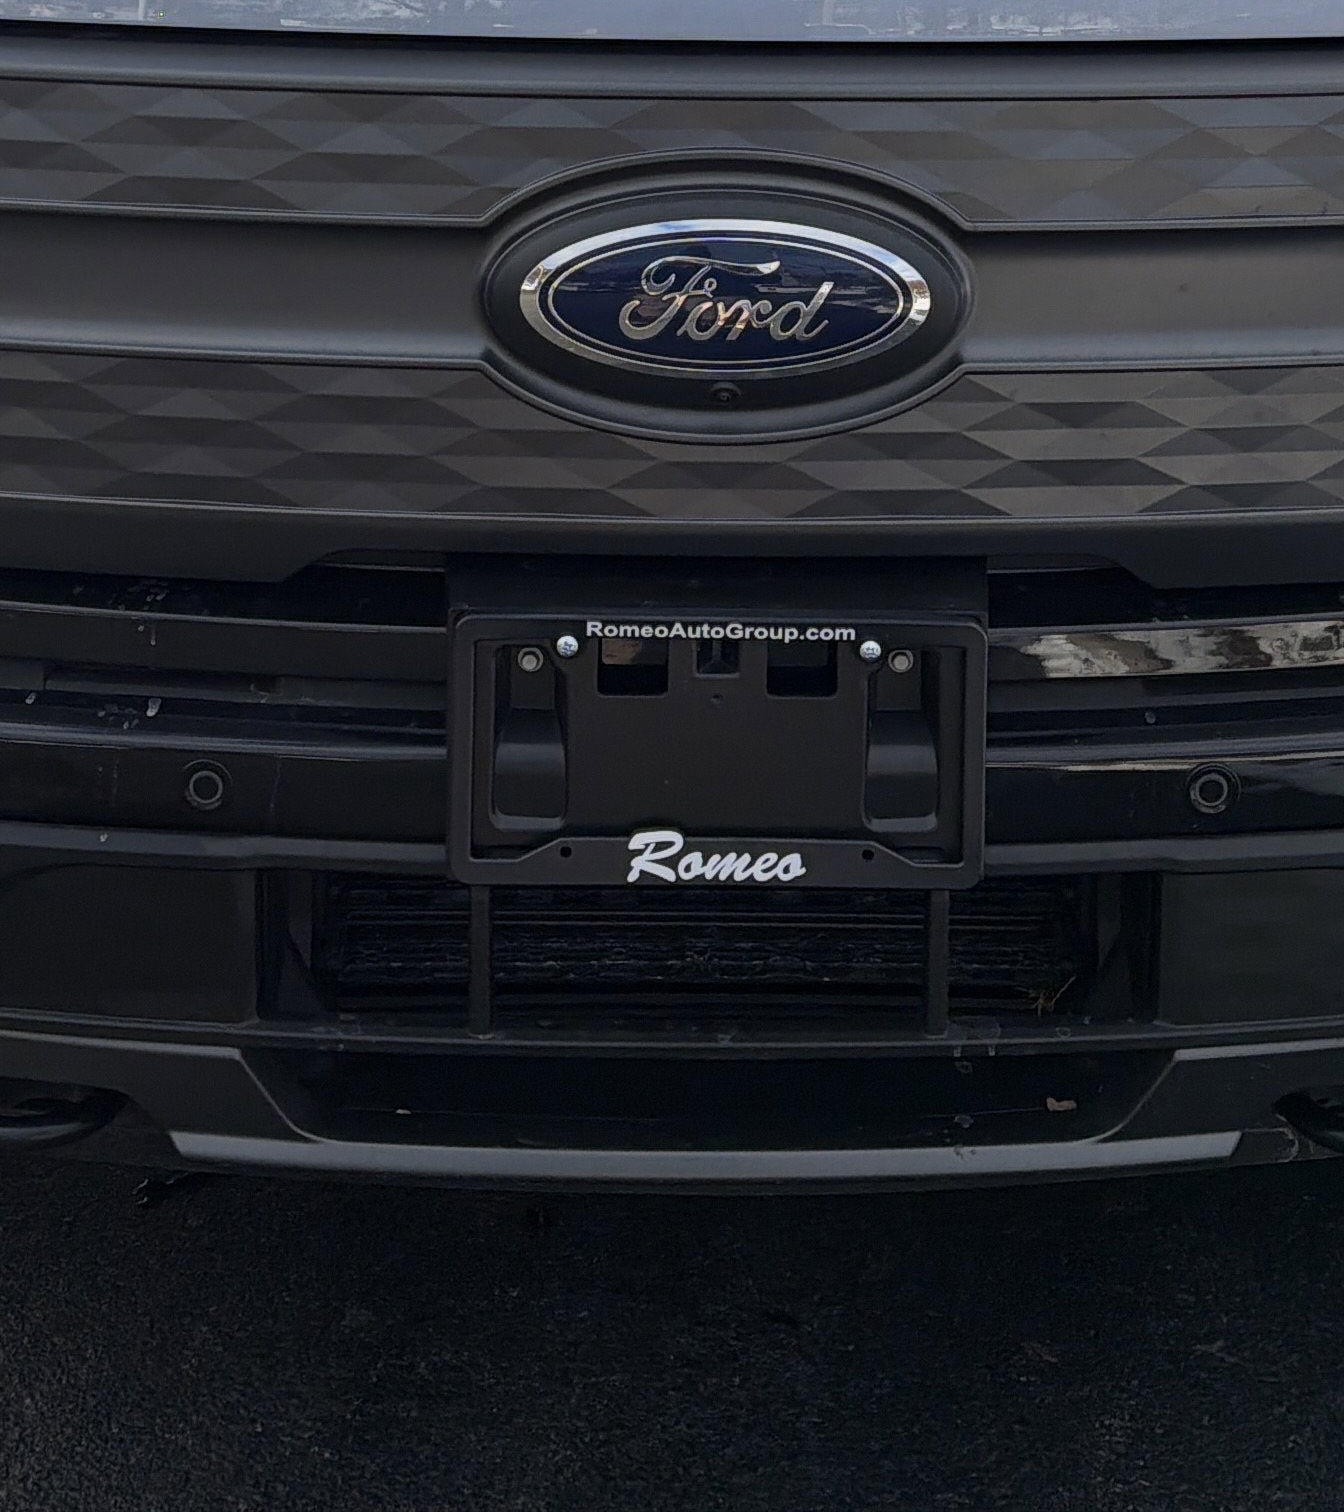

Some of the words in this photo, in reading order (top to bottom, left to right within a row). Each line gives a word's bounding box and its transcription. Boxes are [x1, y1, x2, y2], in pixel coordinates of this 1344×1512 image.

[619, 255, 835, 342] Ford
[586, 621, 856, 643] RomeoAutoGroup.com
[627, 830, 807, 884] Romeo
